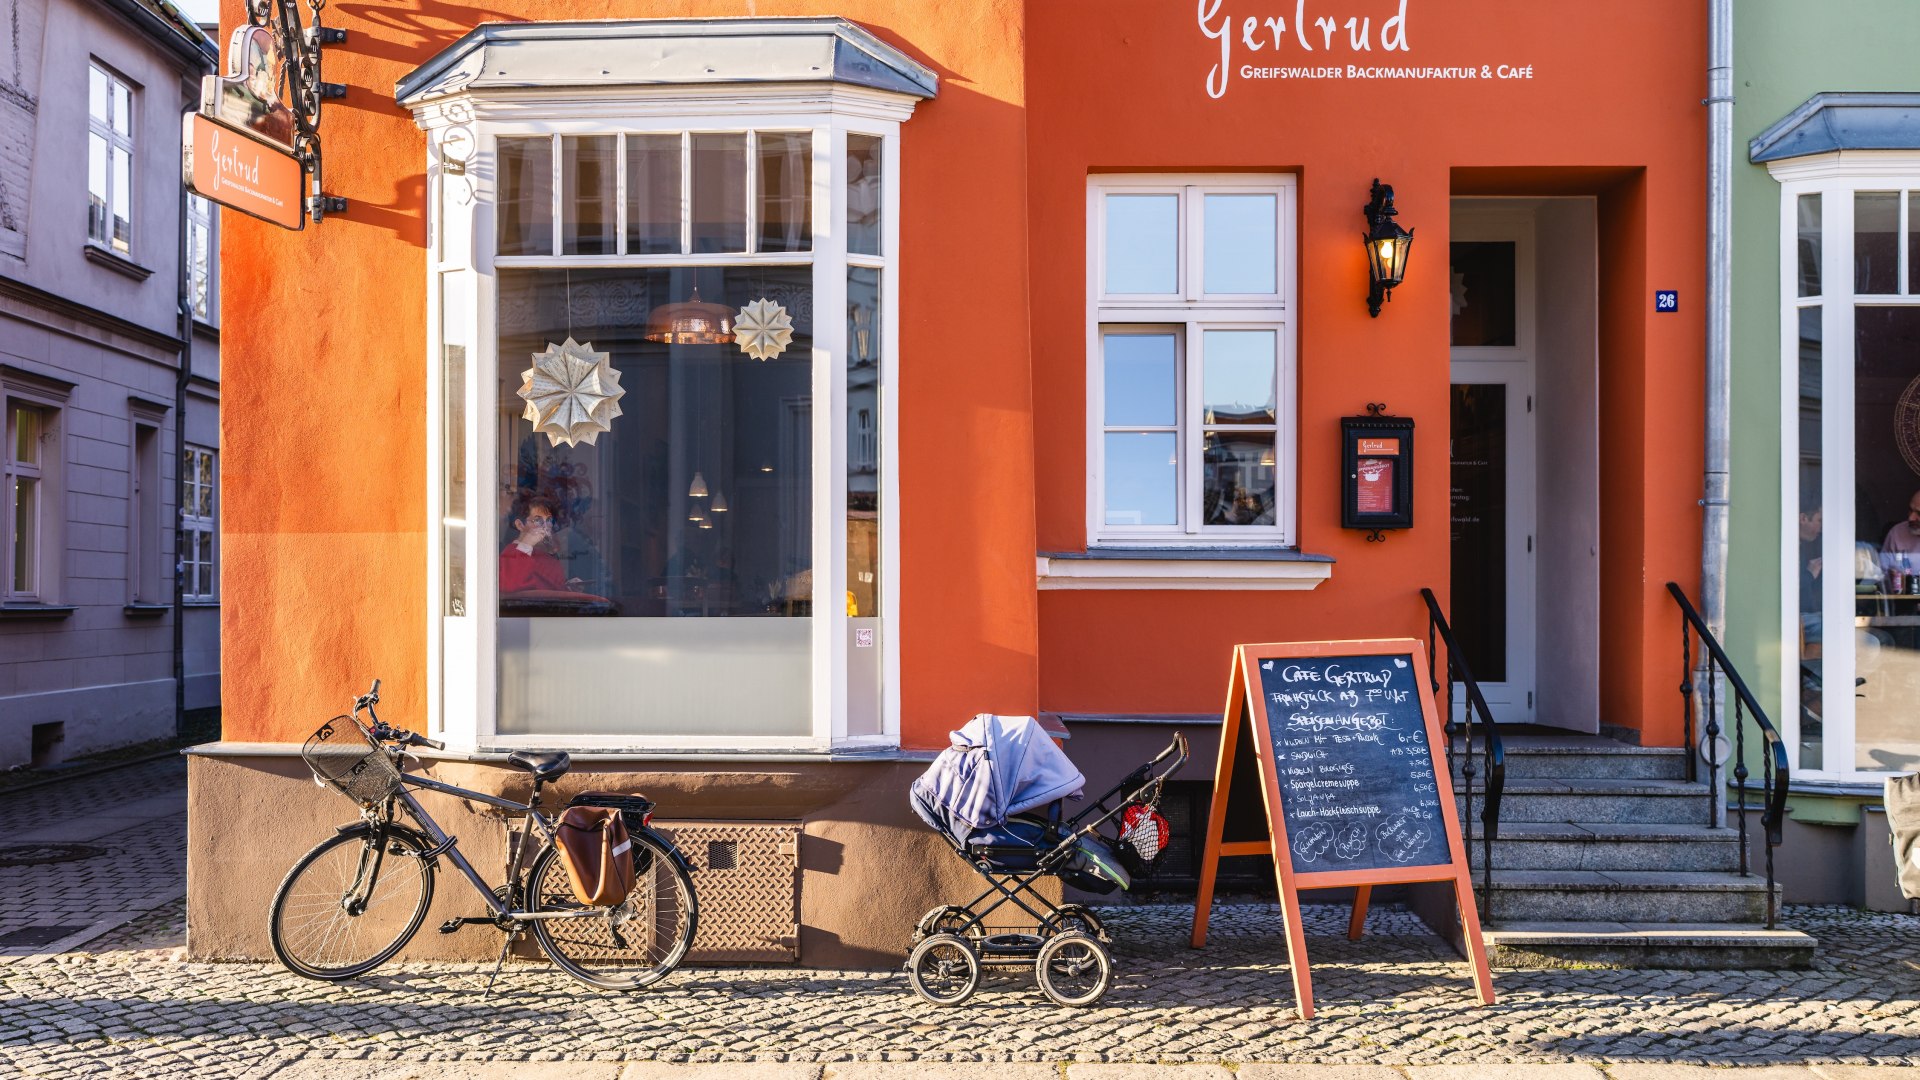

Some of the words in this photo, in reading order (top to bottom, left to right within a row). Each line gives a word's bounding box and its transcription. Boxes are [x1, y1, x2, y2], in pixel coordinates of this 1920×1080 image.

[1198, 0, 1411, 98] Gertrud
[1240, 64, 1342, 79] GREIFSWALDER
[1346, 64, 1476, 79] BACKMANUFAKTUR
[1480, 65, 1493, 79] &
[1497, 64, 1534, 79] CAFÉ
[211, 130, 259, 191] Gertrud
[1658, 293, 1675, 308] 26
[1282, 664, 1321, 683] CAFÉ
[1324, 664, 1392, 688] GERTRUD
